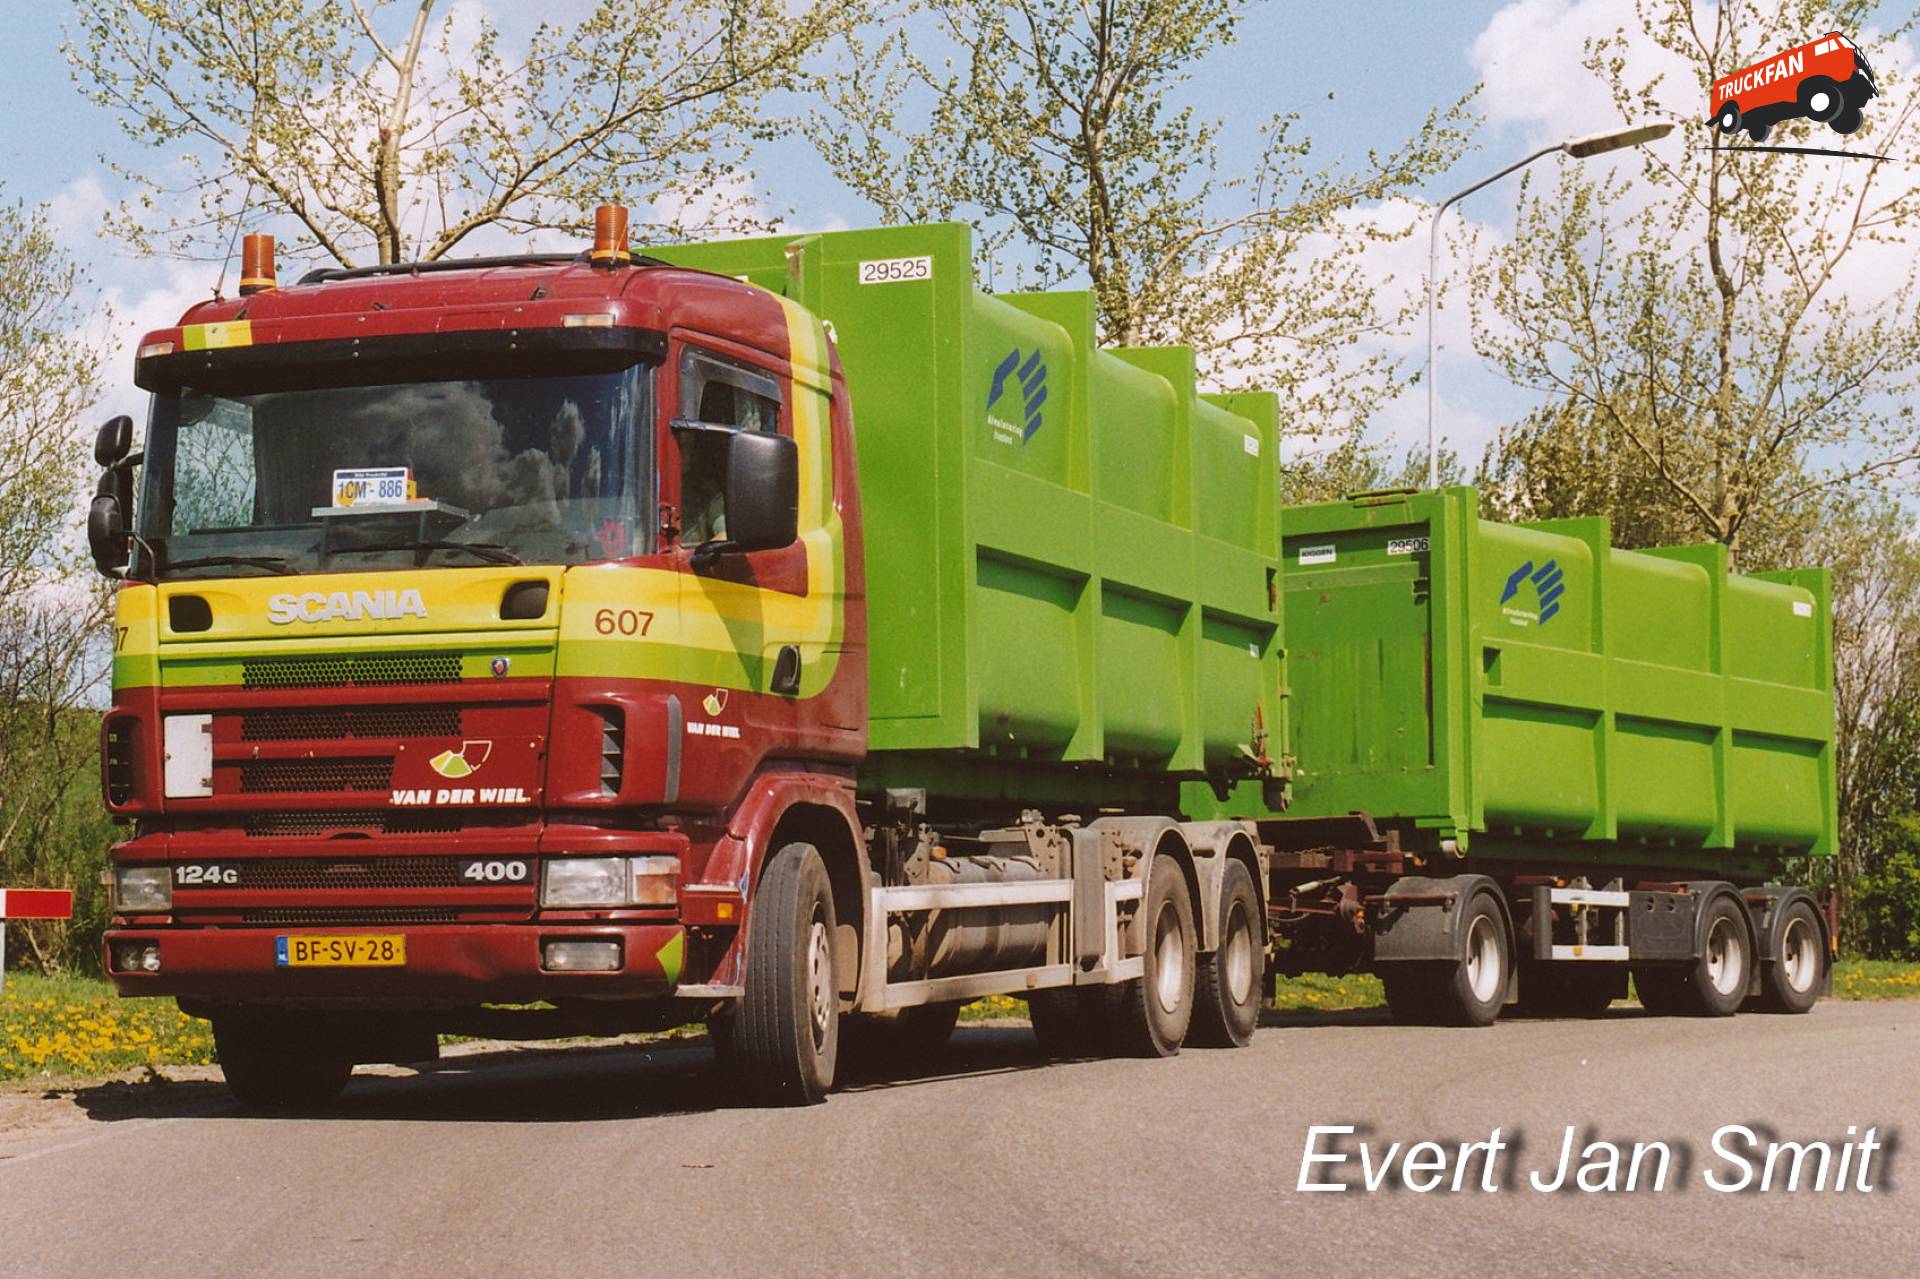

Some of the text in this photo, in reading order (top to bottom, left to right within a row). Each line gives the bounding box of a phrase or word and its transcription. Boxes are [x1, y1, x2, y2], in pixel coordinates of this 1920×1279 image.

[864, 260, 927, 281] 29525
[1389, 538, 1429, 553] 29506
[267, 589, 428, 626] SCANIA
[595, 608, 654, 637] 607
[392, 788, 527, 805] VAN DER WIEL
[175, 865, 238, 884] 124G
[464, 860, 527, 881] 400
[296, 940, 393, 961] BF-SV-28
